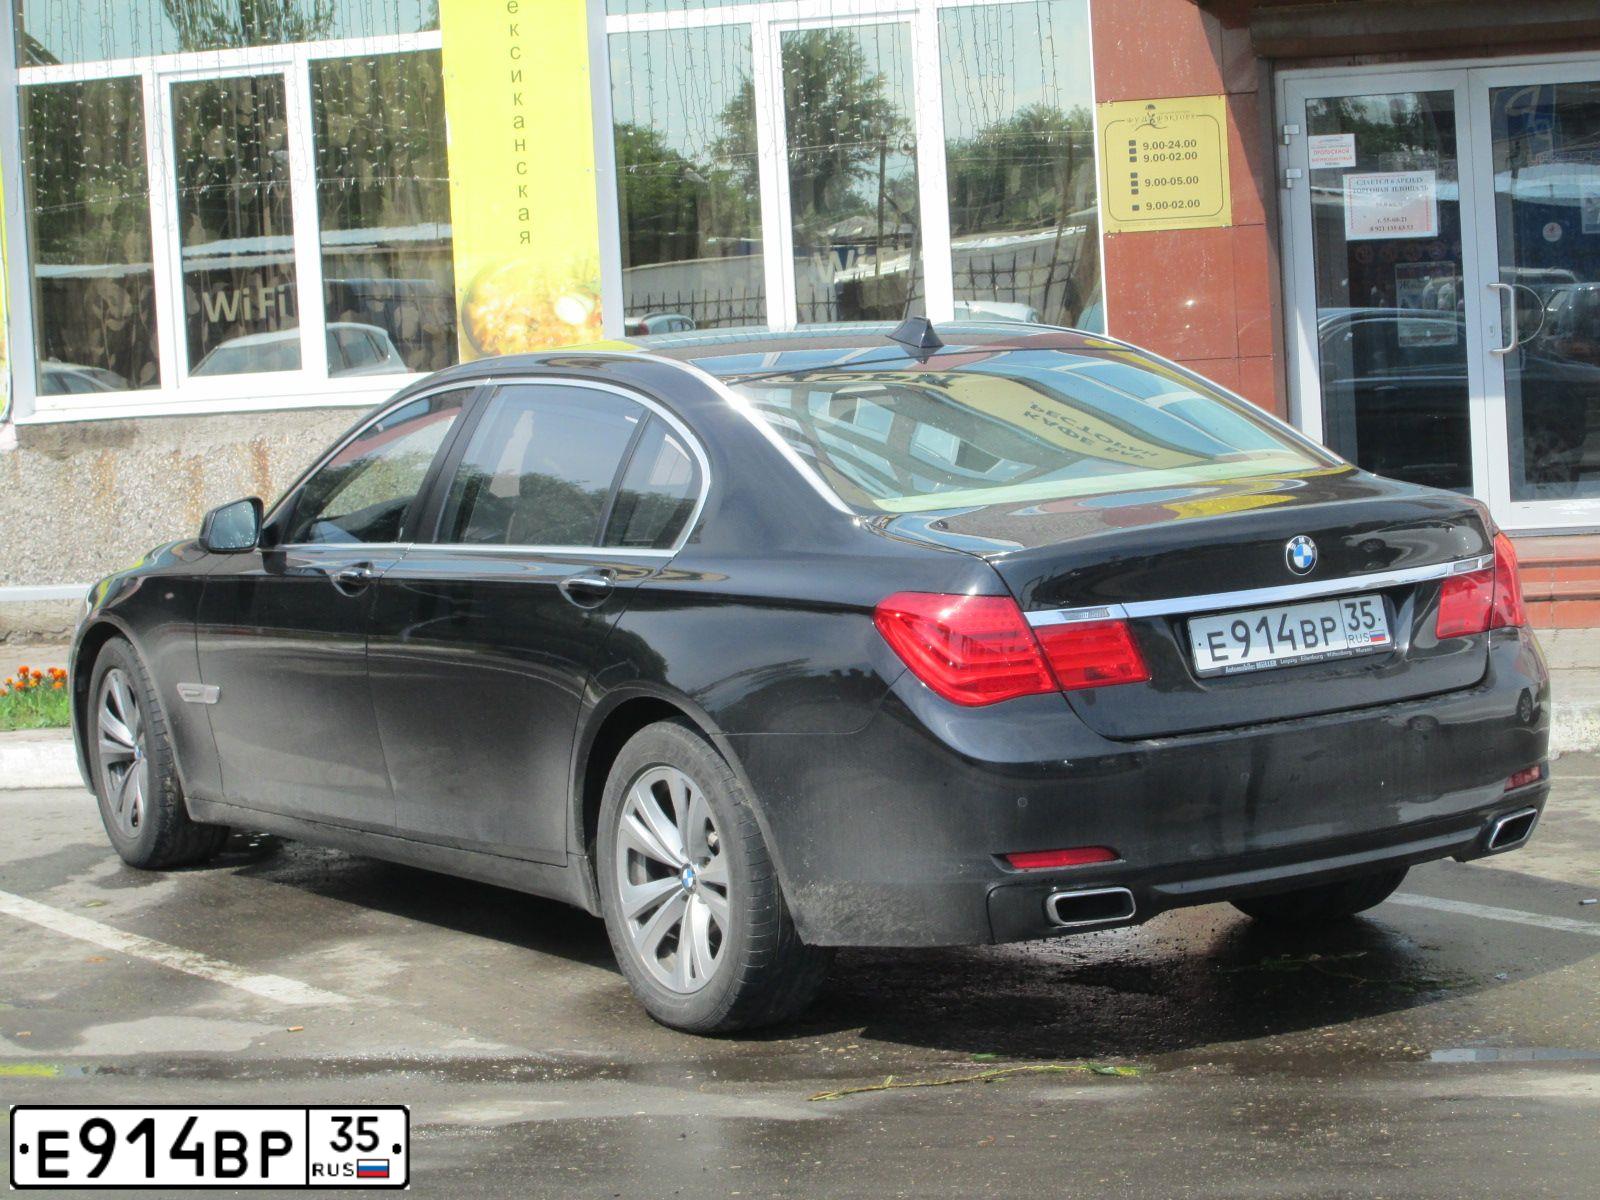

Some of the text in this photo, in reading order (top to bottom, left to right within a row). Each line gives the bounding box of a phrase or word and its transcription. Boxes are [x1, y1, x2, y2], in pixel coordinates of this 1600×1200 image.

[1142, 139, 1197, 151] 9.00-24.00
[1143, 151, 1198, 163] 9.00-02.00
[1144, 175, 1199, 187] 9.00-05.00
[1145, 199, 1201, 211] 9.00-02.00
[202, 285, 287, 322] WiFi
[1344, 601, 1376, 631] 35
[1347, 632, 1370, 644] RUS
